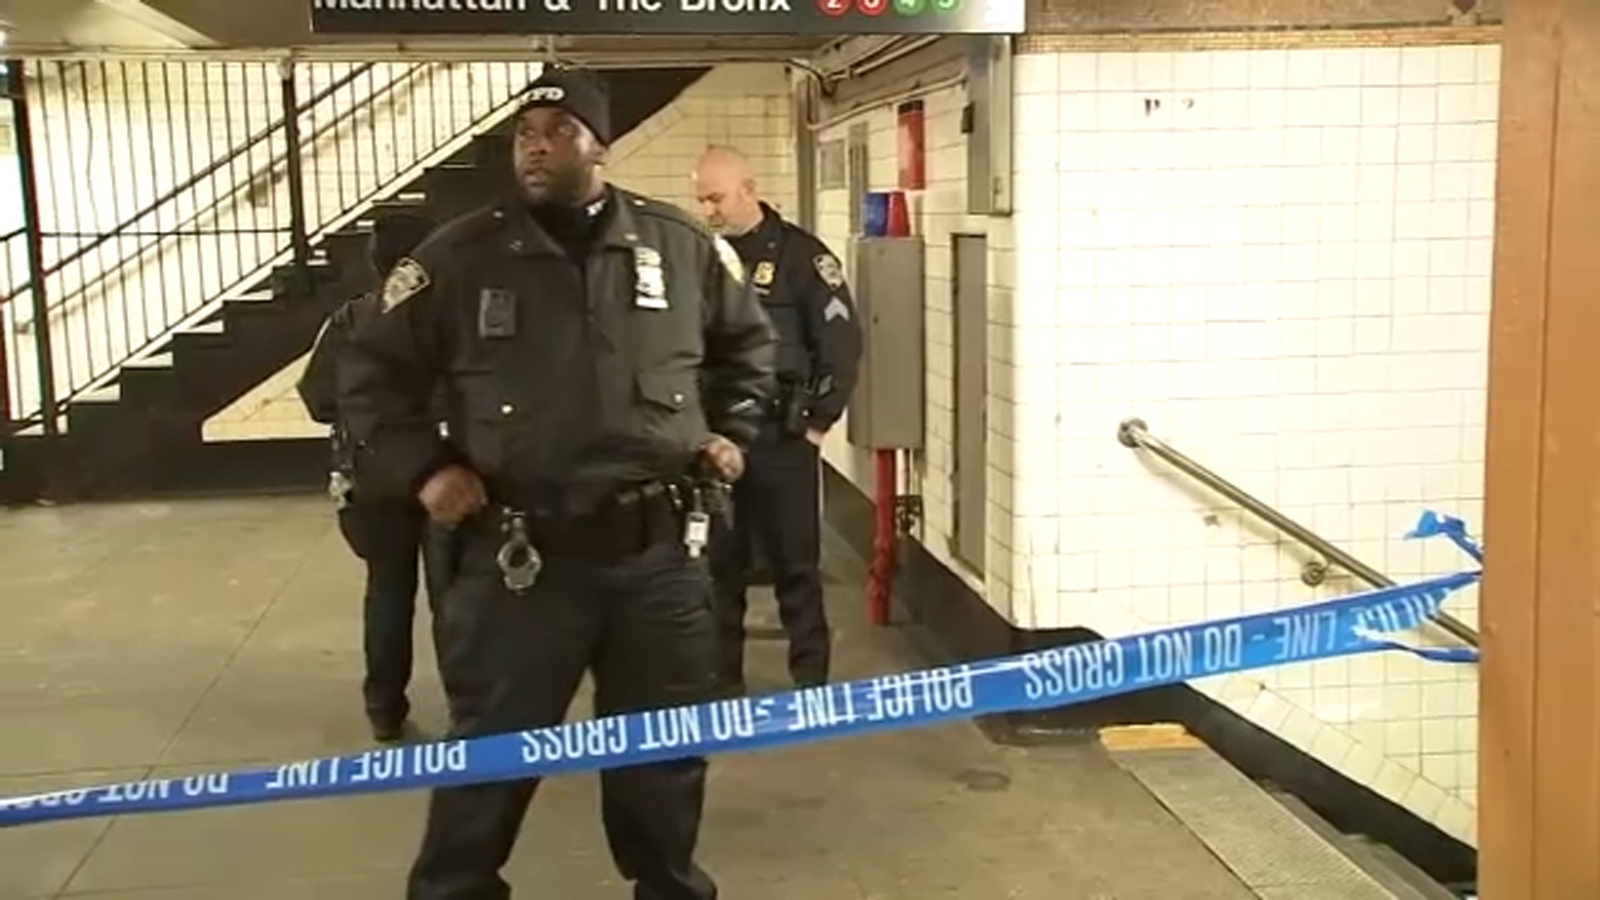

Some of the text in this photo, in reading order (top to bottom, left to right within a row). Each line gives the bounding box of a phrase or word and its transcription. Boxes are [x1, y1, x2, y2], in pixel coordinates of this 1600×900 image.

[516, 86, 565, 106] YPD
[1134, 629, 1193, 684] NOT
[1203, 623, 1242, 671] DO
[1272, 611, 1337, 661] LINE
[864, 664, 973, 721] POLICE
[1021, 640, 1124, 700] CROSS
[521, 714, 628, 763] CROSS
[639, 704, 701, 751] NOT
[710, 697, 755, 741] DO
[351, 740, 467, 782] POLICE
